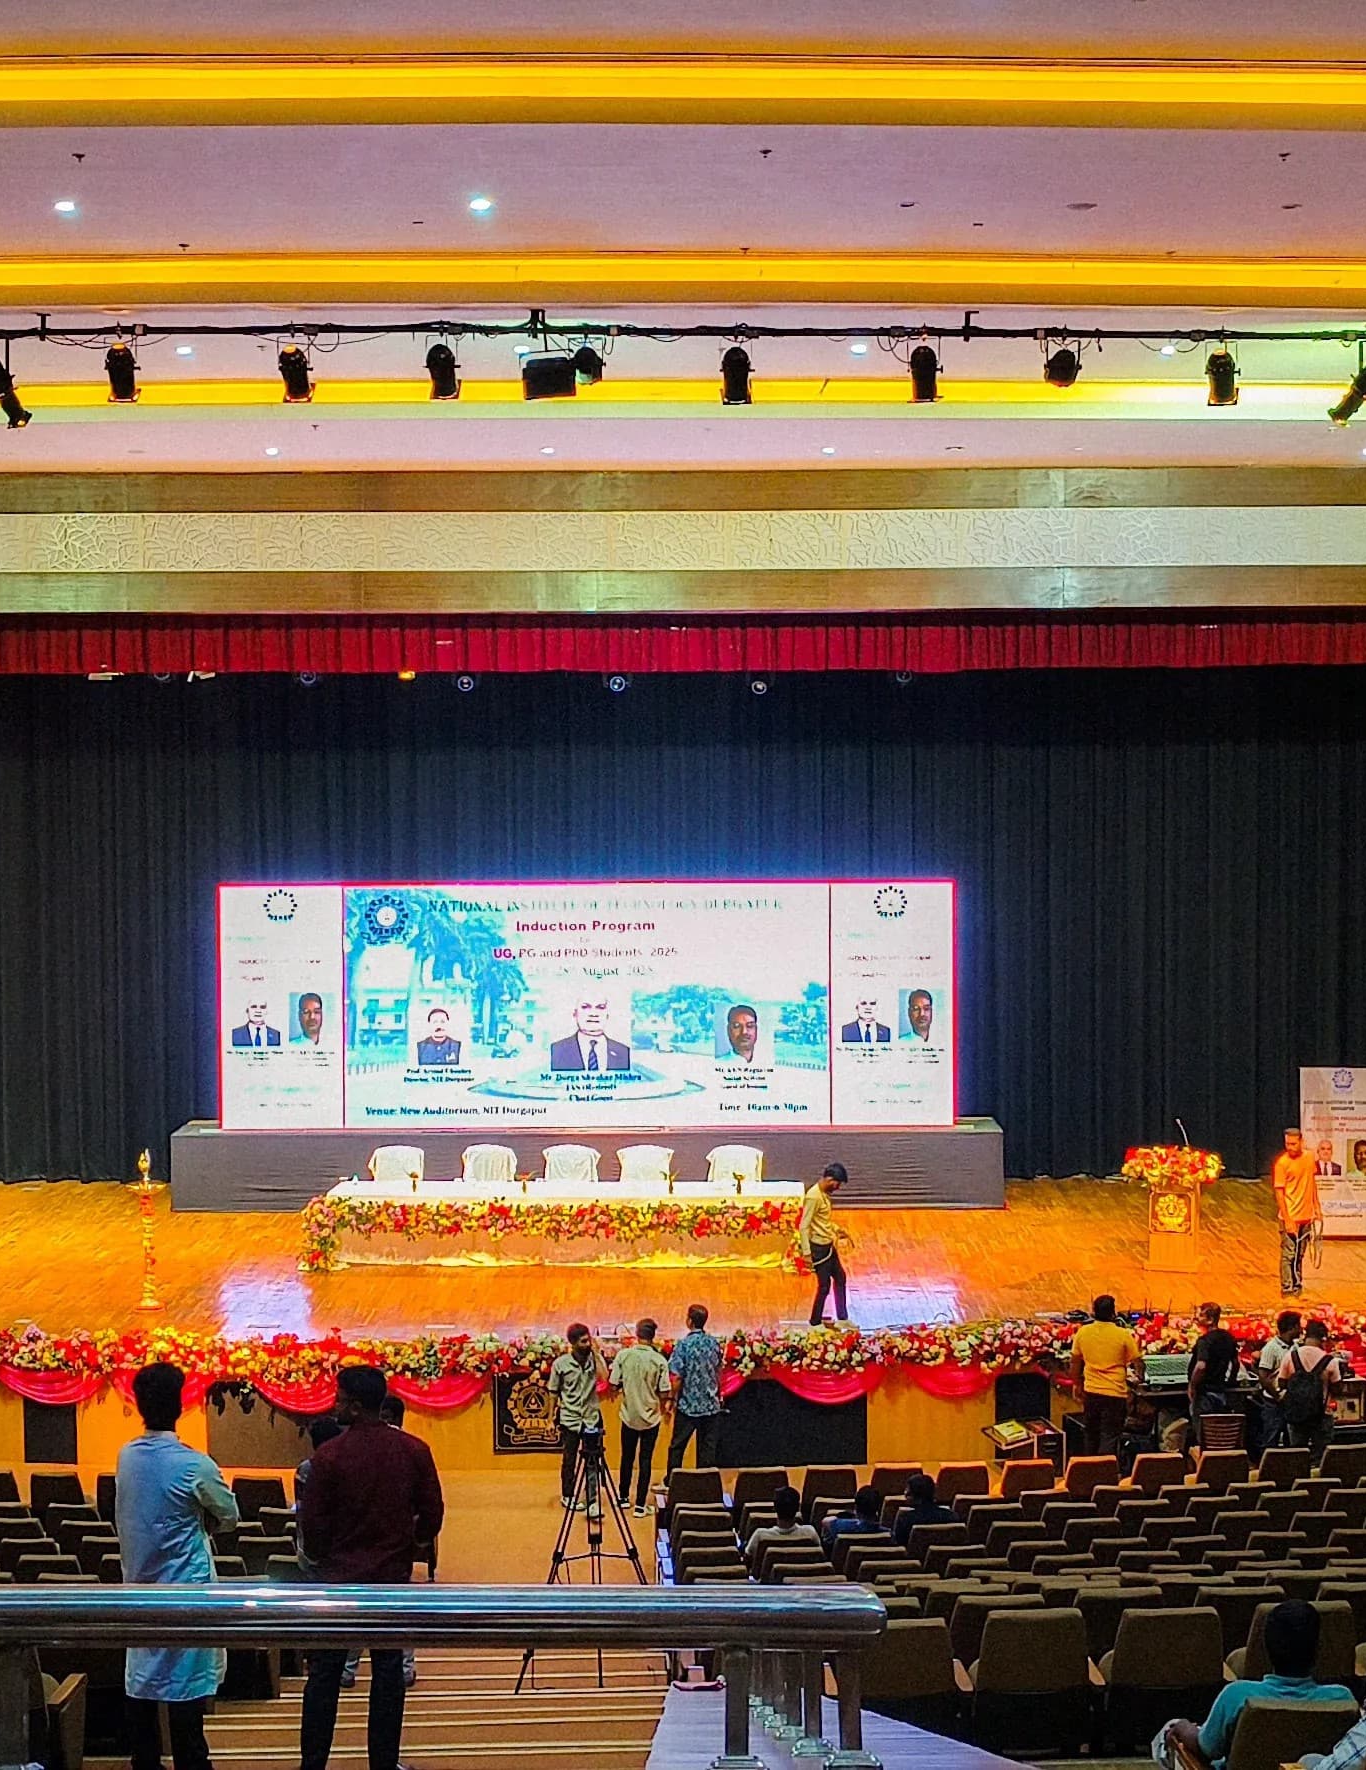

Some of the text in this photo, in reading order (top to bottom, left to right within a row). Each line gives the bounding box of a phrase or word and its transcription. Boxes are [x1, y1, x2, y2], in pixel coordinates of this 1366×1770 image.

[427, 900, 503, 912] NATIONAL
[516, 920, 655, 933] Induction Program
[493, 948, 515, 960] UG,
[518, 948, 536, 958] PG
[539, 948, 561, 958] and
[564, 948, 588, 958] PhD
[400, 1106, 420, 1115] New
[483, 1106, 499, 1114] NIT
[503, 1106, 547, 1117] Durgapur
